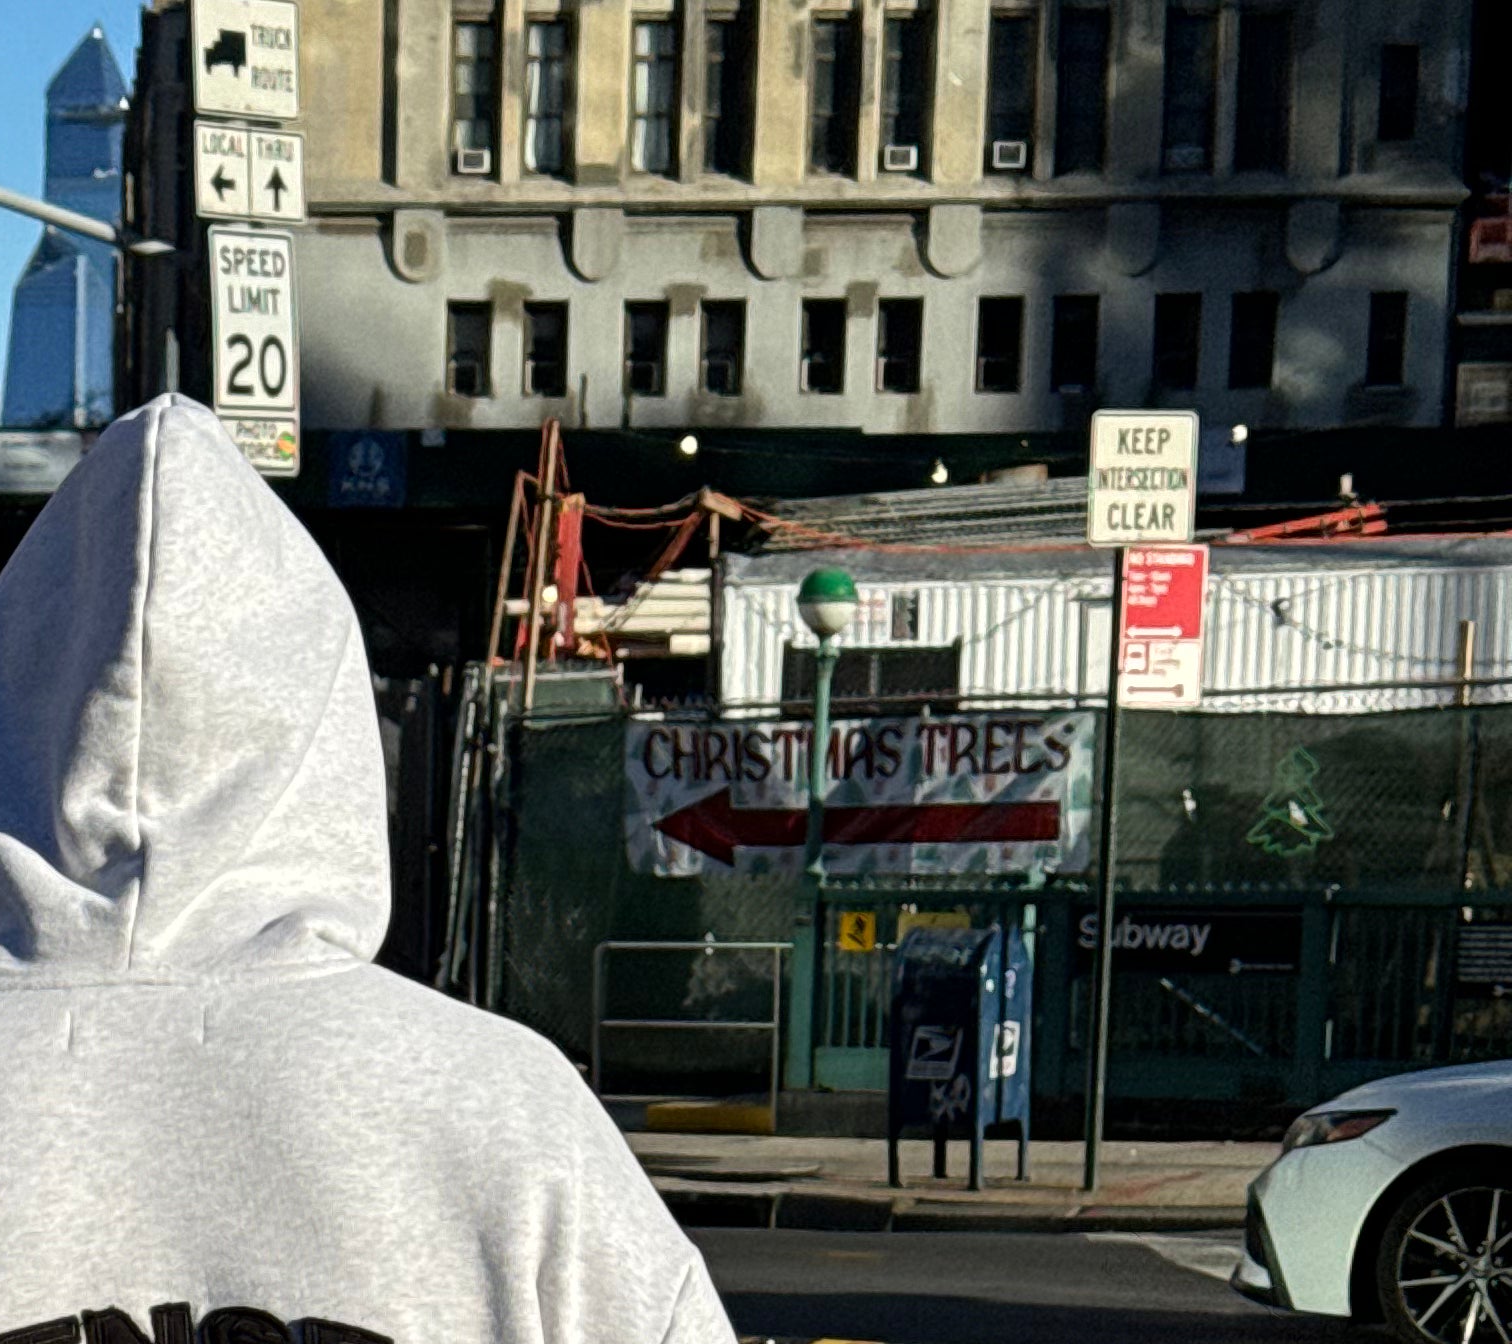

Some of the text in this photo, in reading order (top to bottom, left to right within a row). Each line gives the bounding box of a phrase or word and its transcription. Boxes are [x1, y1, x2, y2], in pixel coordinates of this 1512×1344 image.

[250, 25, 292, 50] TRUCK
[250, 66, 293, 93] ROUTE
[201, 132, 245, 158] LOCAL
[255, 136, 294, 162] THRU
[220, 246, 286, 277] SPEED
[228, 284, 280, 315] LIMIT
[227, 333, 287, 398] 20
[1117, 427, 1171, 455] KEEP
[1096, 467, 1189, 492] INTERSECTION
[1107, 503, 1175, 531] CLEAR
[642, 718, 1072, 781] CHRISTMAS TREES
[1078, 912, 1211, 957] Subway
